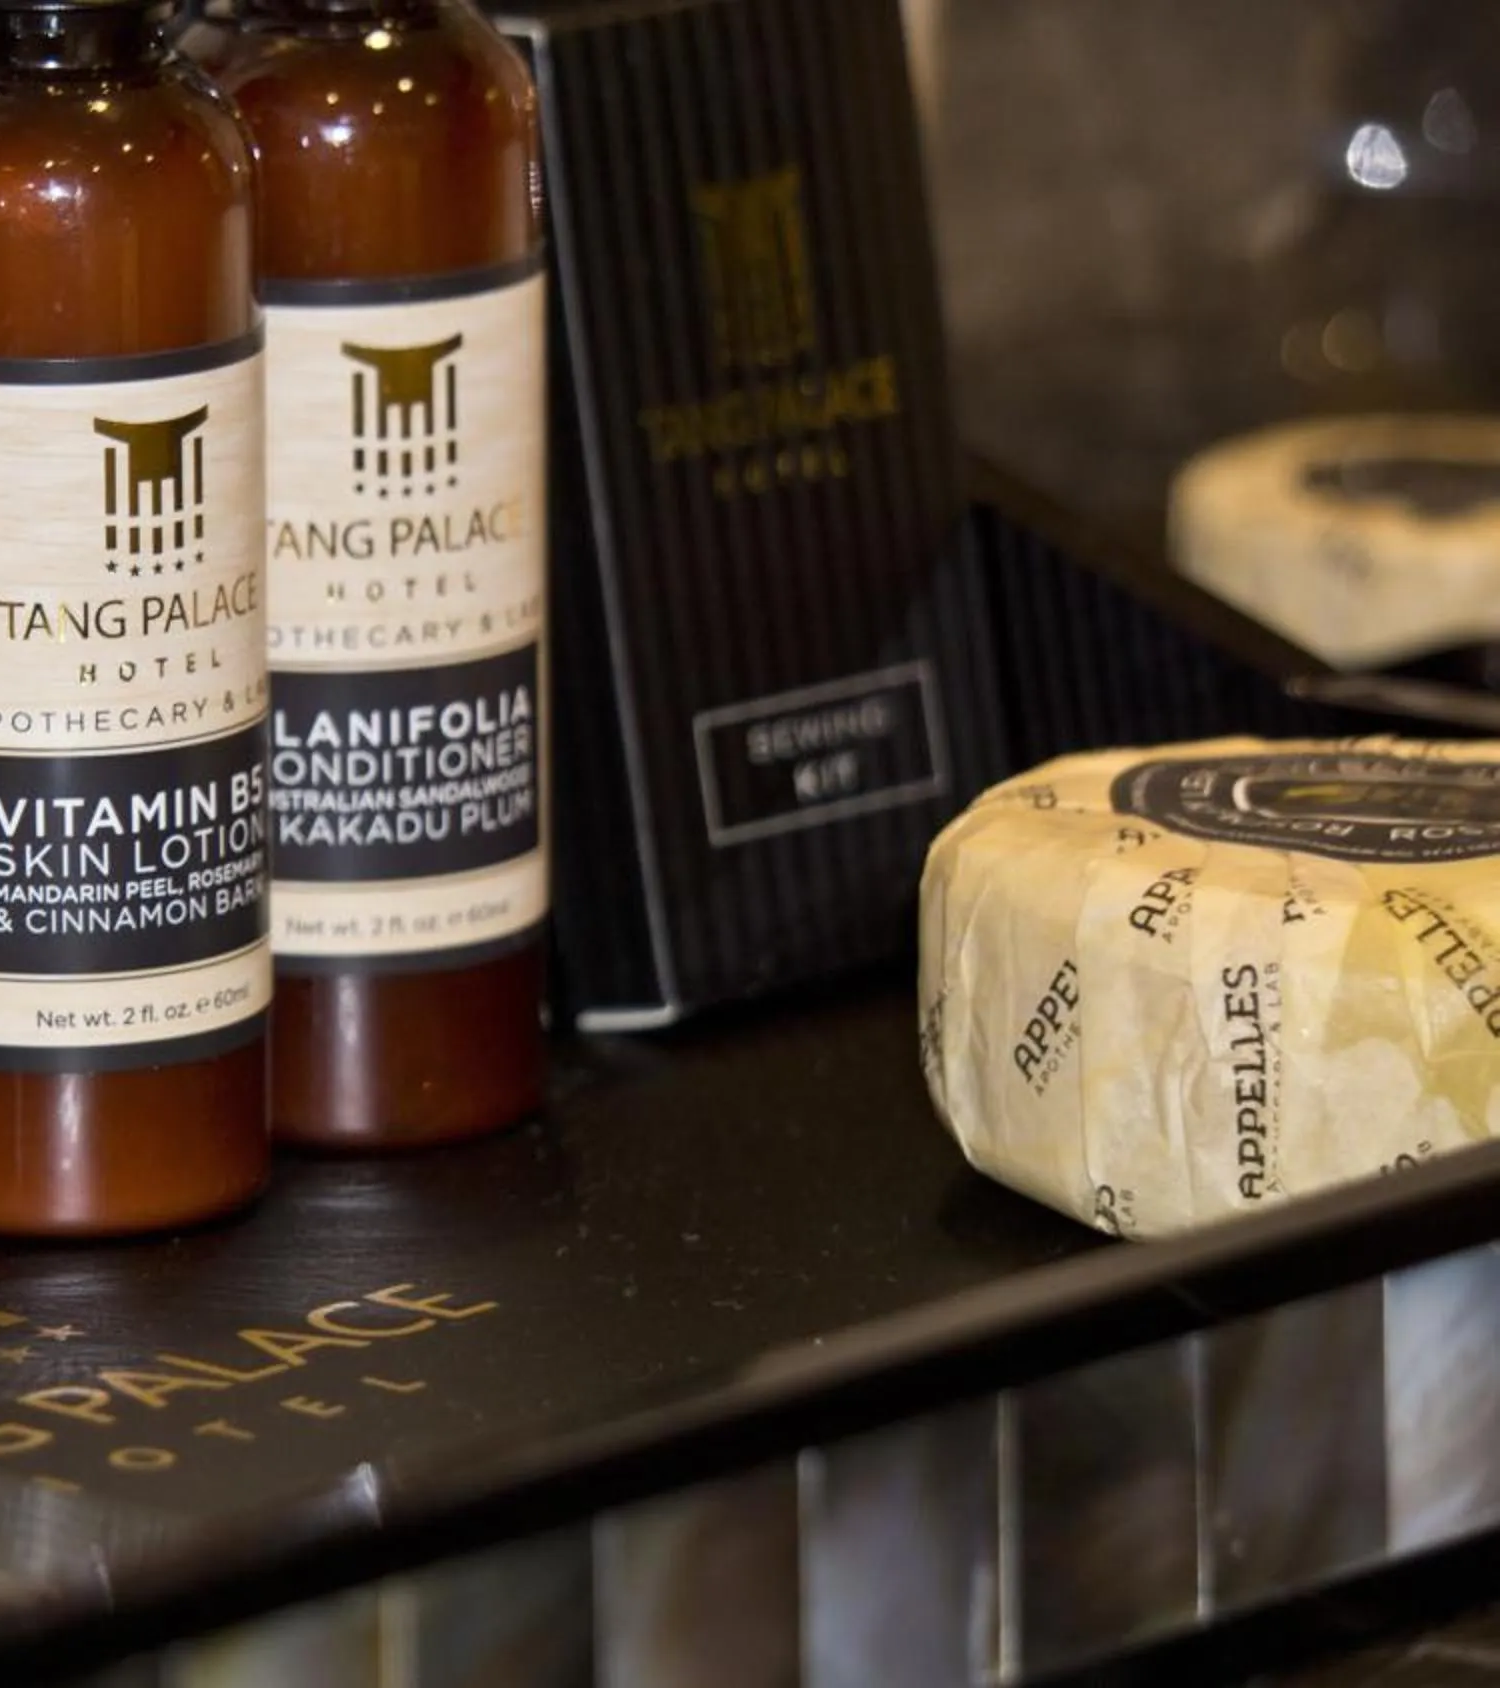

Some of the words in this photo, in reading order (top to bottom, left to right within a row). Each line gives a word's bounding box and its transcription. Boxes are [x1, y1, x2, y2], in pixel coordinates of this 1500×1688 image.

[267, 517, 375, 560] ANG
[142, 571, 258, 636] PALACE
[327, 571, 477, 602] HOTEL
[79, 648, 221, 686] HOTEL
[222, 689, 235, 714] &
[274, 684, 532, 749] LANIFOLIA
[272, 723, 532, 787] ONDITIONER
[231, 765, 263, 814] B5
[134, 812, 265, 873] LOTION
[279, 808, 451, 847] KAKADU
[460, 790, 533, 835] PLUM
[126, 877, 184, 901] PEEL,
[25, 895, 208, 934] CINNAMON
[36, 1010, 77, 1030] Net
[83, 1010, 116, 1028] wt.
[123, 1007, 136, 1026] 2
[214, 983, 249, 1010] 60ml
[1222, 962, 1267, 1200] APPELLES
[16, 1283, 499, 1423] PALACE
